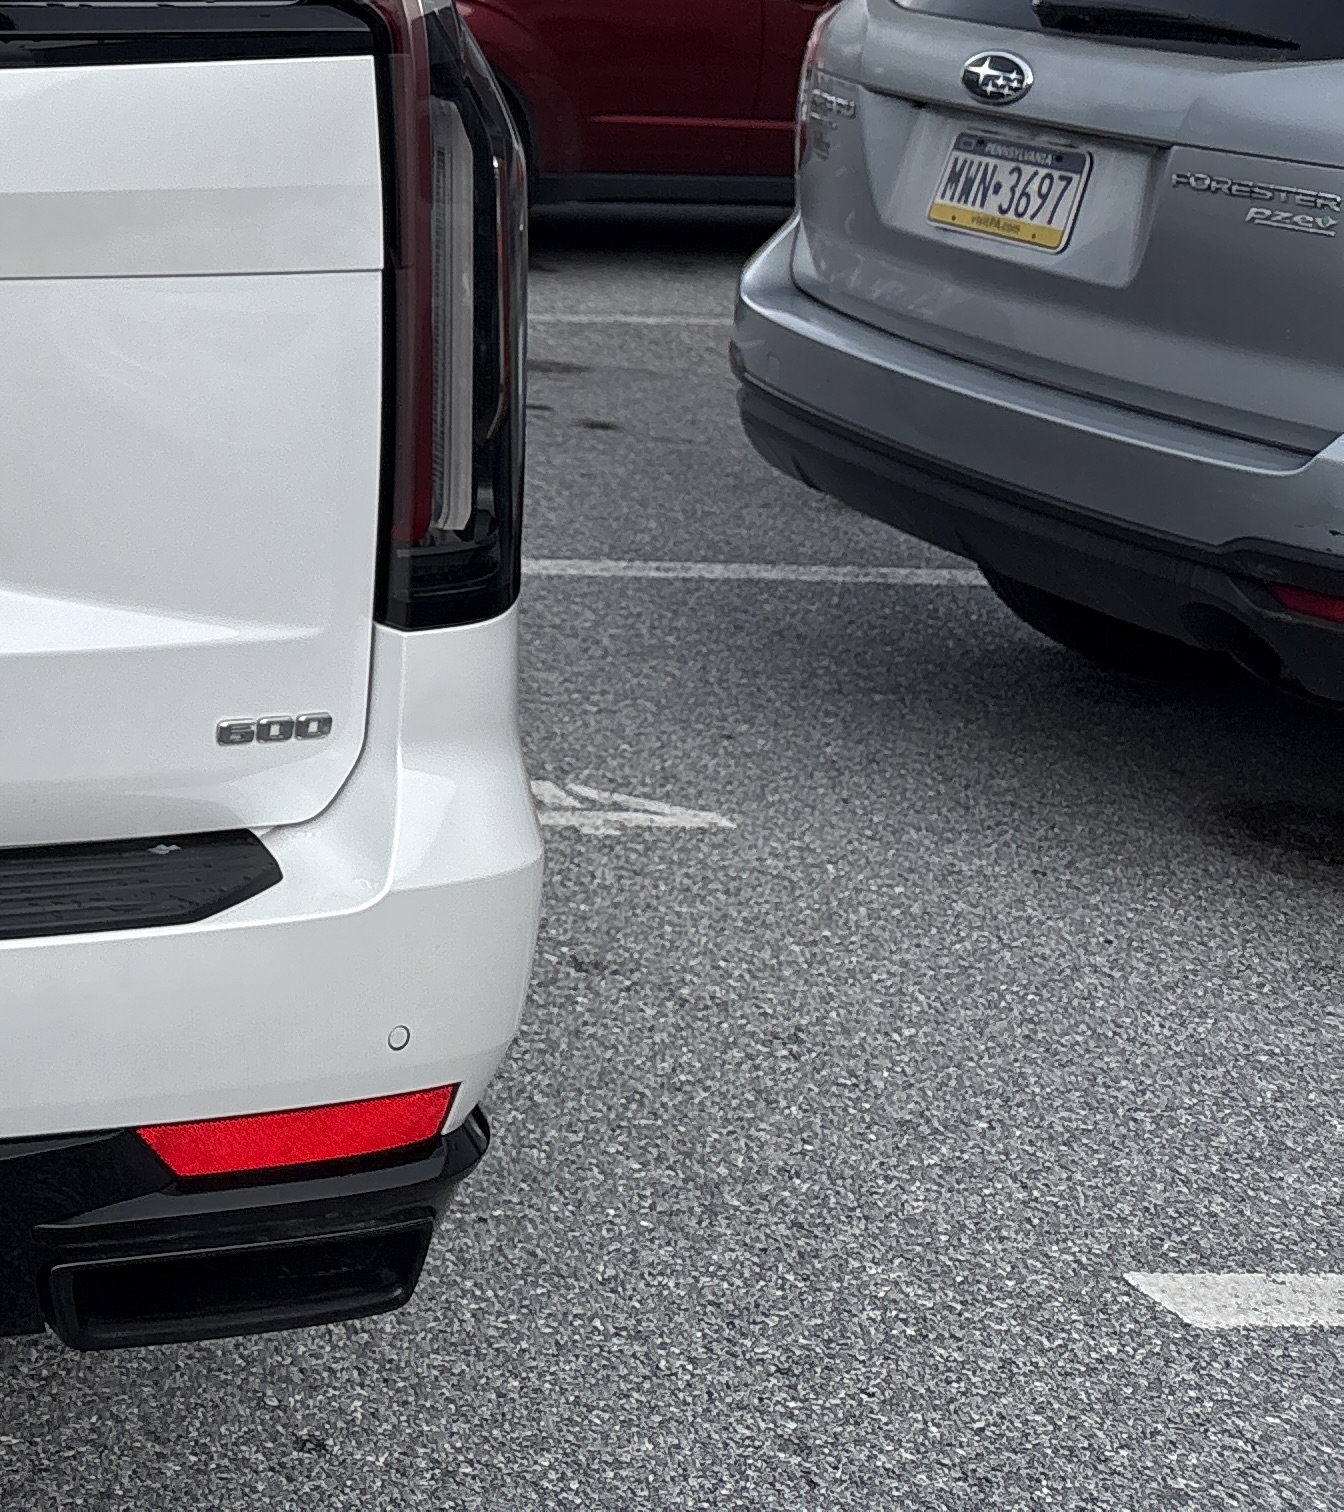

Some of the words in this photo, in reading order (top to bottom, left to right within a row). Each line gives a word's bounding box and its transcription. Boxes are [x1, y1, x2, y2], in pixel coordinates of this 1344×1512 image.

[984, 141, 1052, 166] PENNSYLVANIA
[1171, 171, 1342, 212] FORESTER
[216, 711, 333, 746] 600
